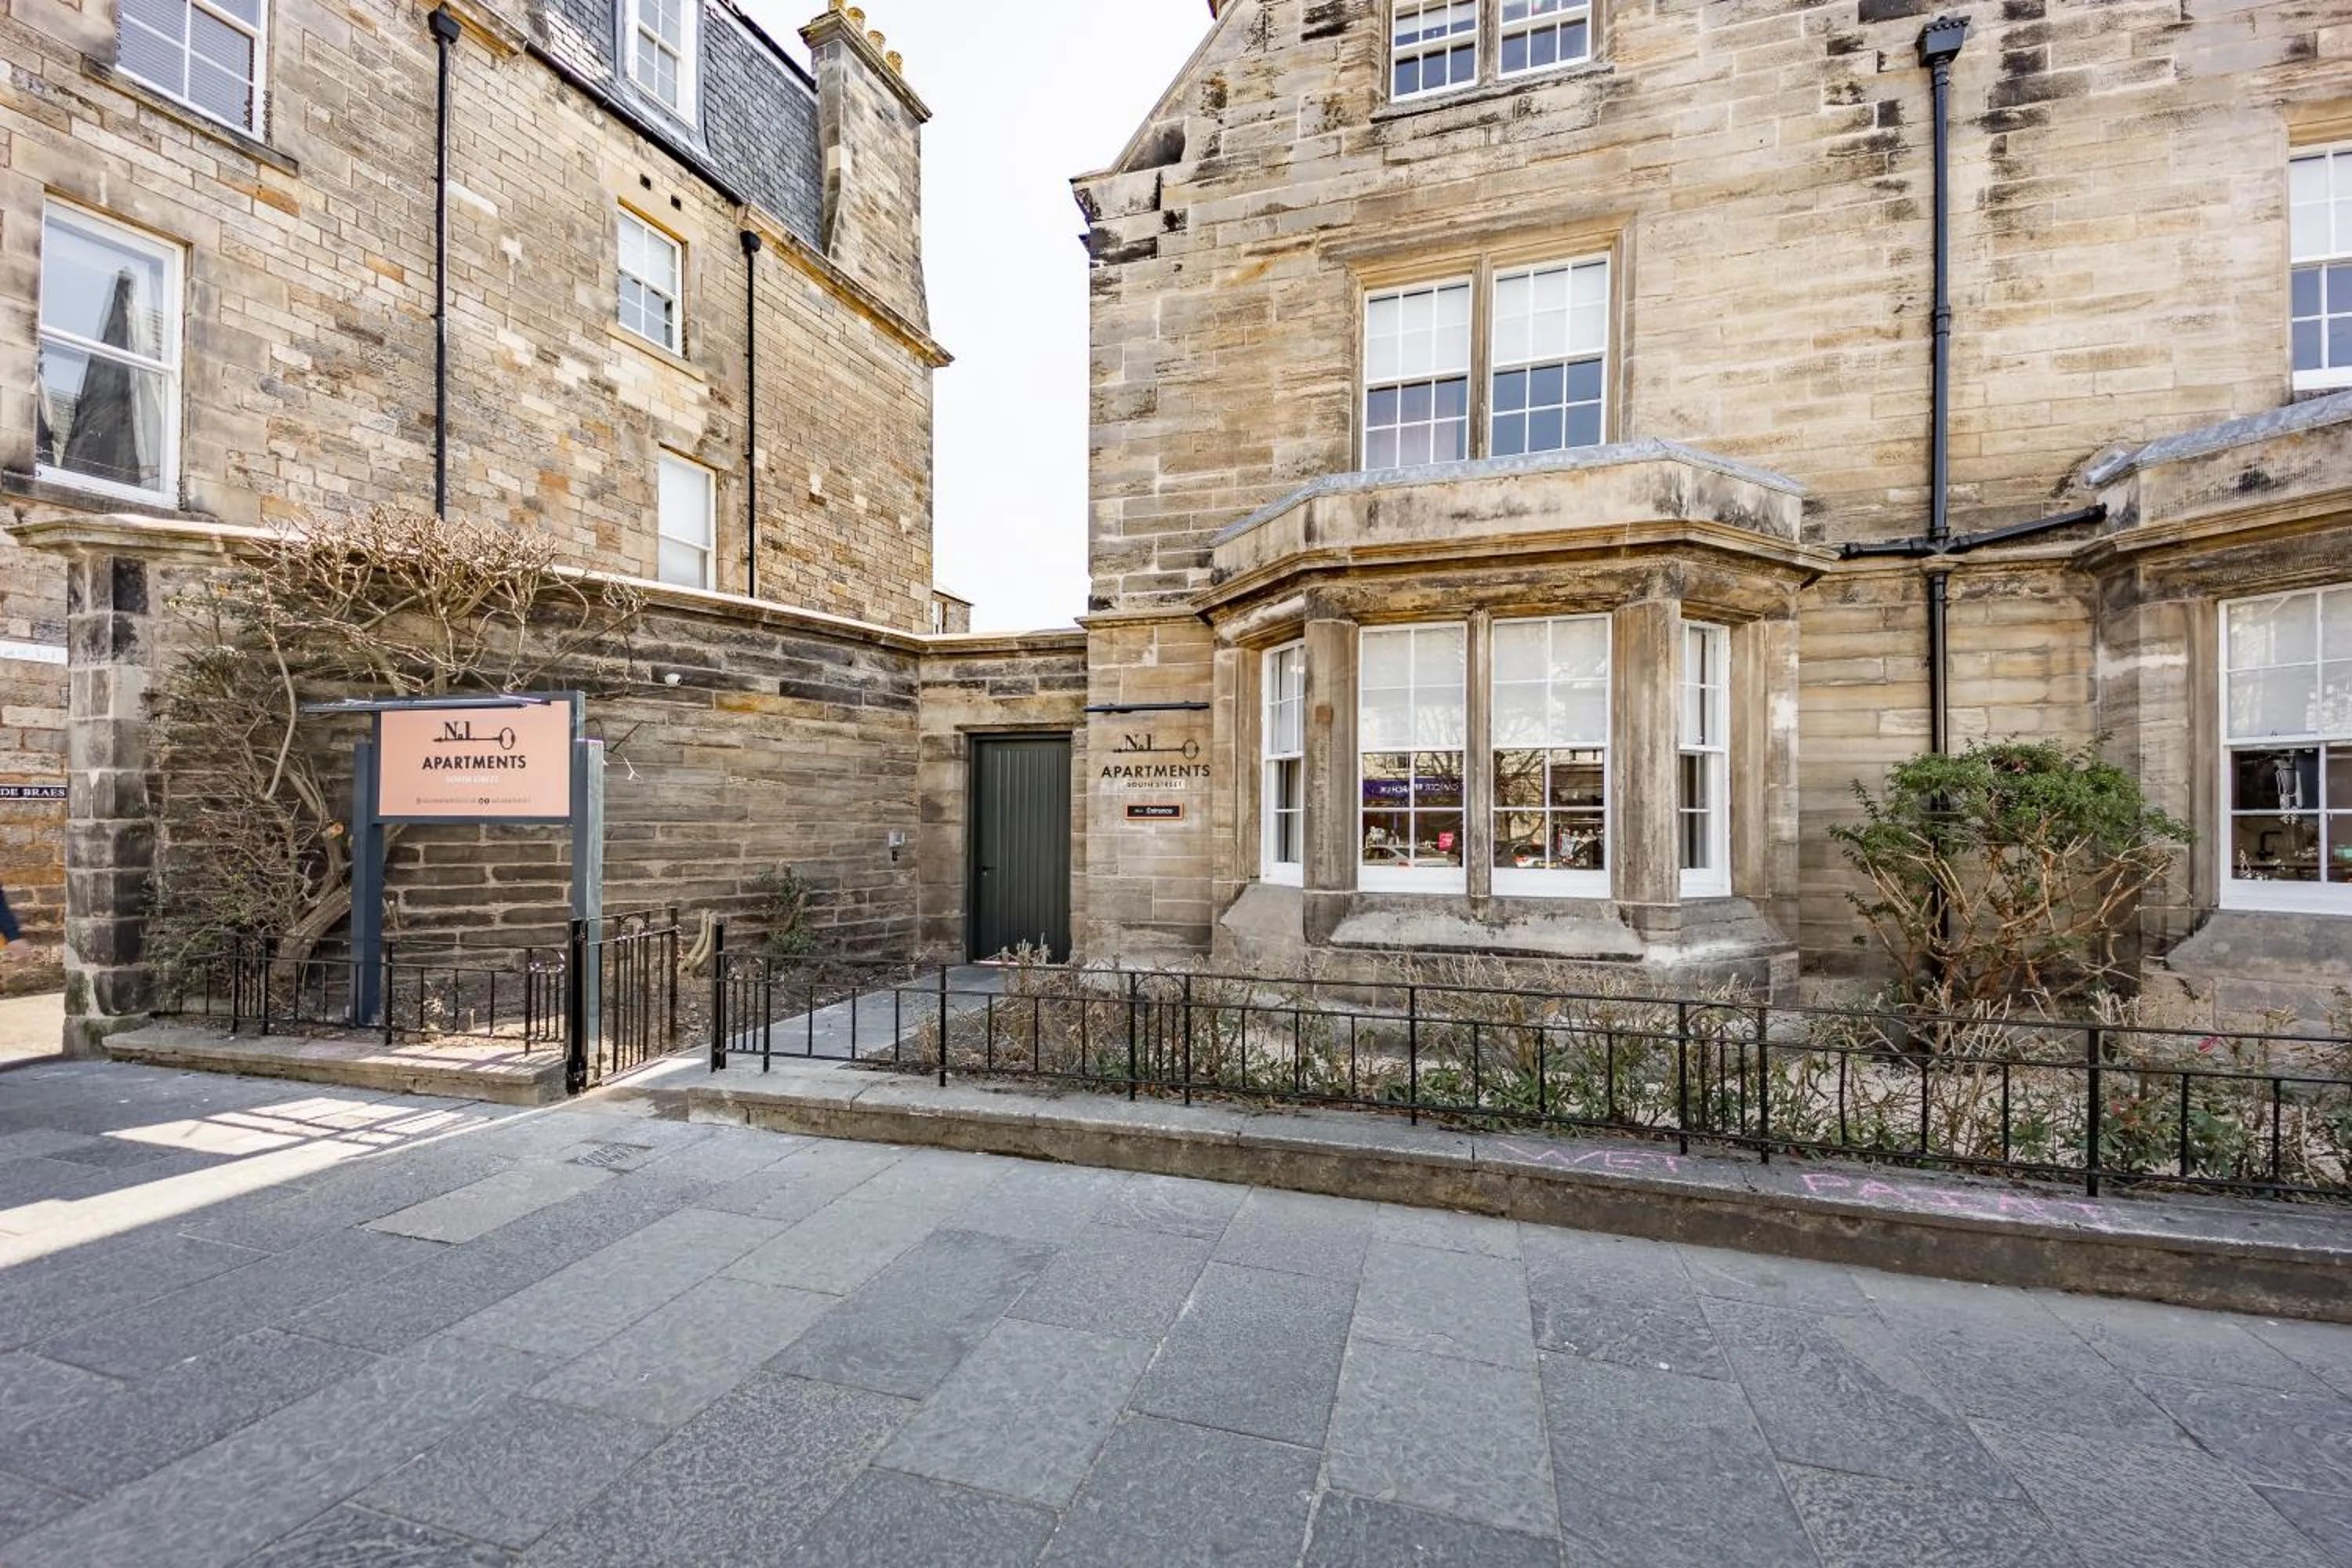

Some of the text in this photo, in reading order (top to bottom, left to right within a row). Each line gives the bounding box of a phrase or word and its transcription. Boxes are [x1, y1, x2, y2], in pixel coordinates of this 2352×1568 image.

[422, 754, 527, 770] APARTMENTS
[1101, 764, 1210, 779] APARTMENTS
[1497, 1140, 1682, 1174] WET
[1802, 1173, 2103, 1218] PAINT
